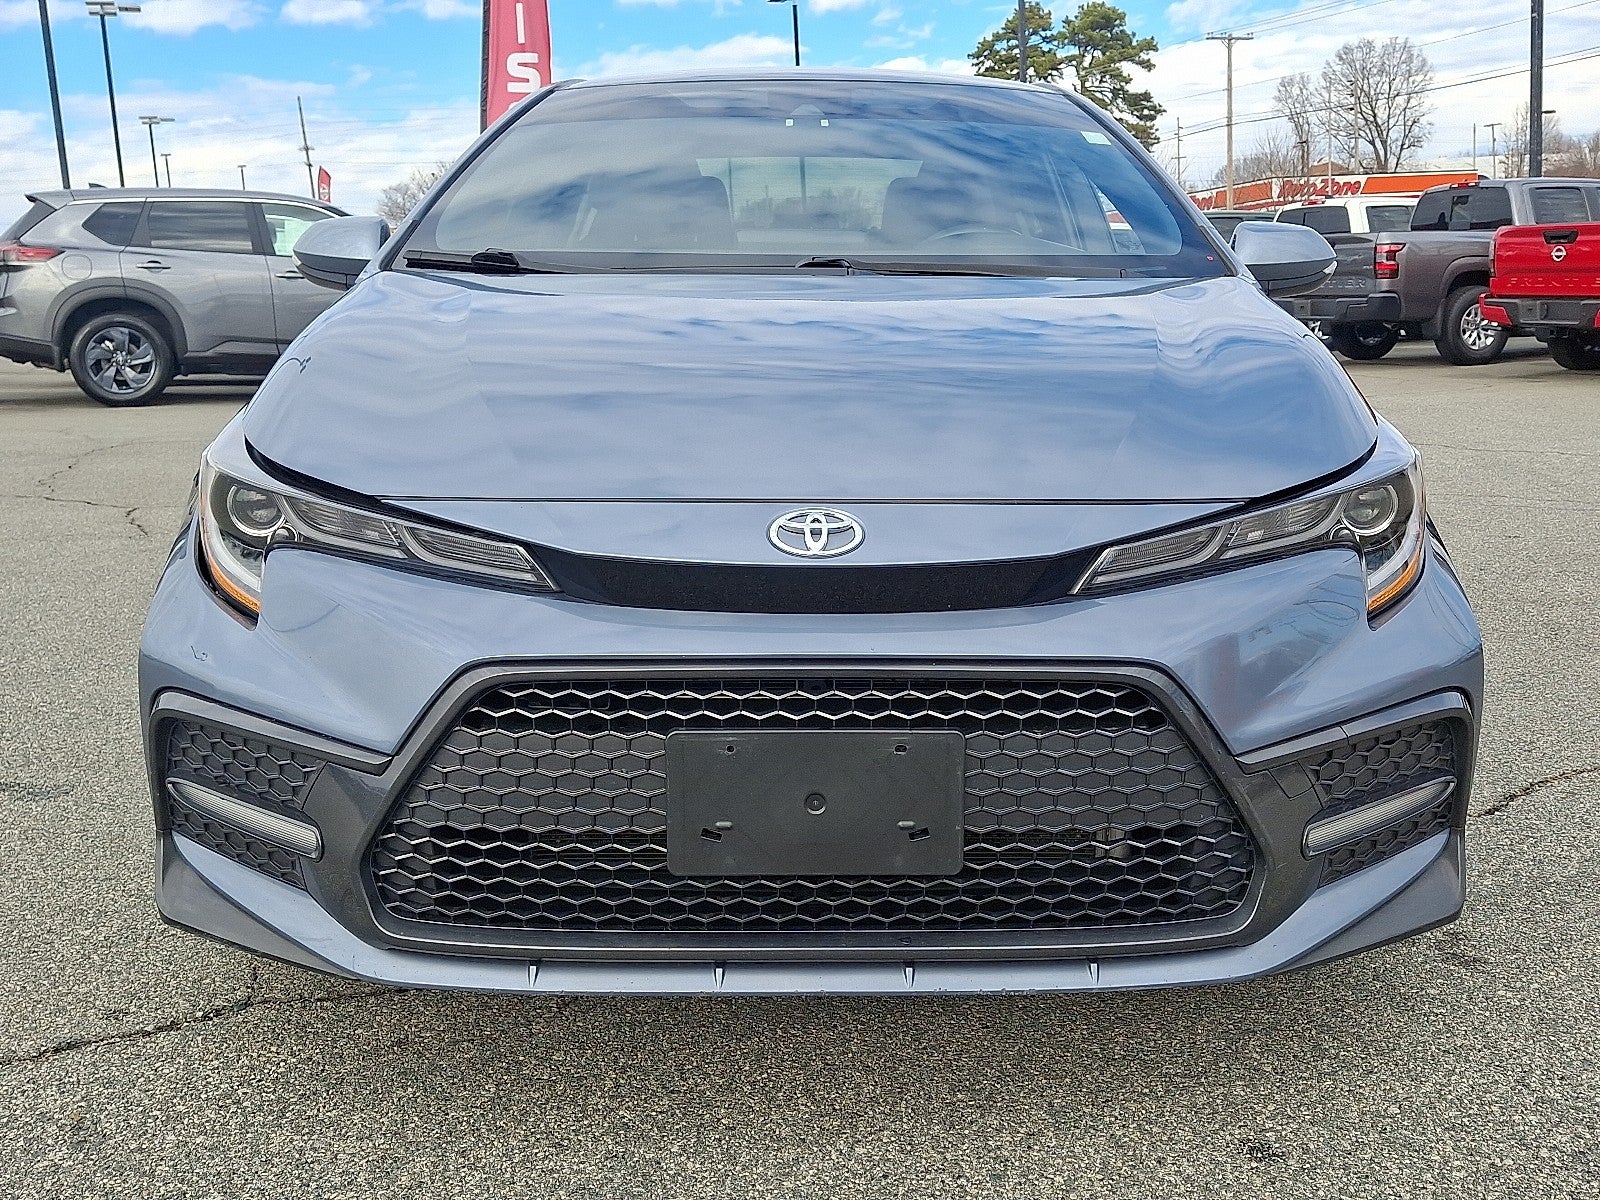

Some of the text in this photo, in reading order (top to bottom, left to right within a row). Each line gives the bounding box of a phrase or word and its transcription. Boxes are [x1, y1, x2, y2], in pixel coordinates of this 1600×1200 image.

[506, 2, 541, 110] IS
[1277, 178, 1362, 198] AutoZone
[1321, 280, 1366, 288] TIER
